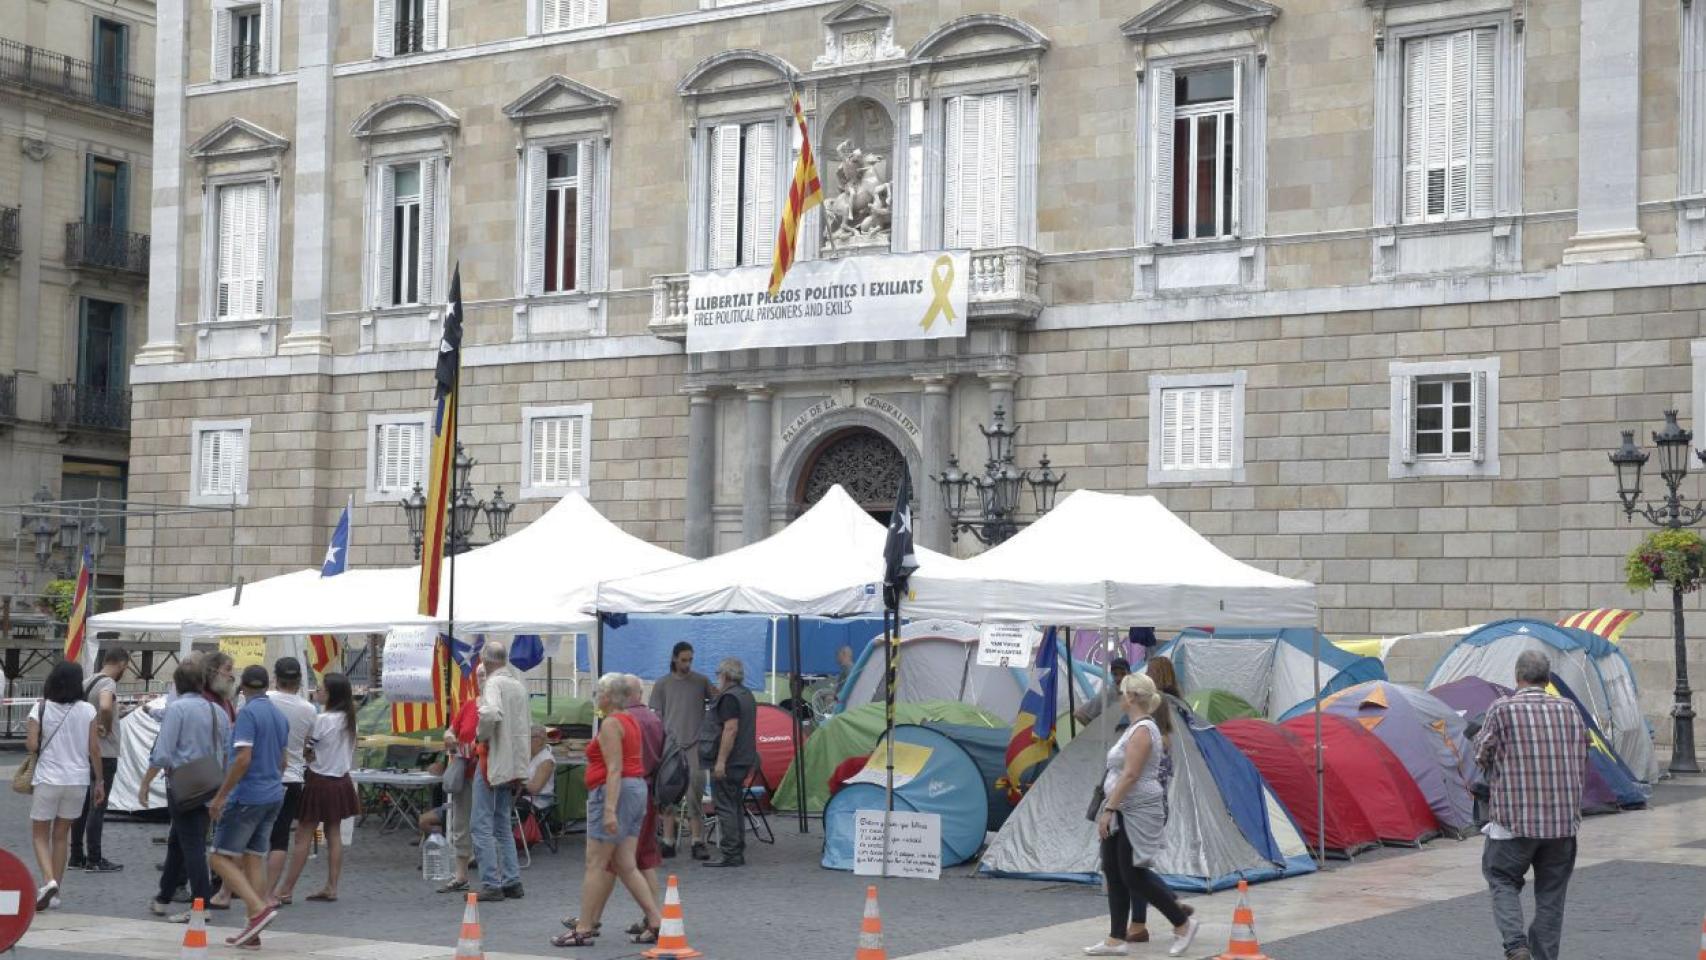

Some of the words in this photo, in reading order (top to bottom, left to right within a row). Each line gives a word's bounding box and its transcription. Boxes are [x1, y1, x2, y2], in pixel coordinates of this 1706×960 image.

[695, 292, 754, 310] LLIBERTAT
[757, 288, 801, 305] PRESOS
[804, 282, 857, 301] POLÍTICS
[861, 283, 866, 297] I
[870, 279, 924, 297] EXILIATS
[694, 311, 714, 327] FREE
[715, 308, 755, 324] POLITICAL
[757, 303, 803, 321] PRISONERS
[804, 302, 823, 317] AND
[782, 415, 806, 442] PALAU
[810, 404, 823, 417] DE
[824, 399, 837, 411] LA
[863, 396, 918, 436] GENERALITAT
